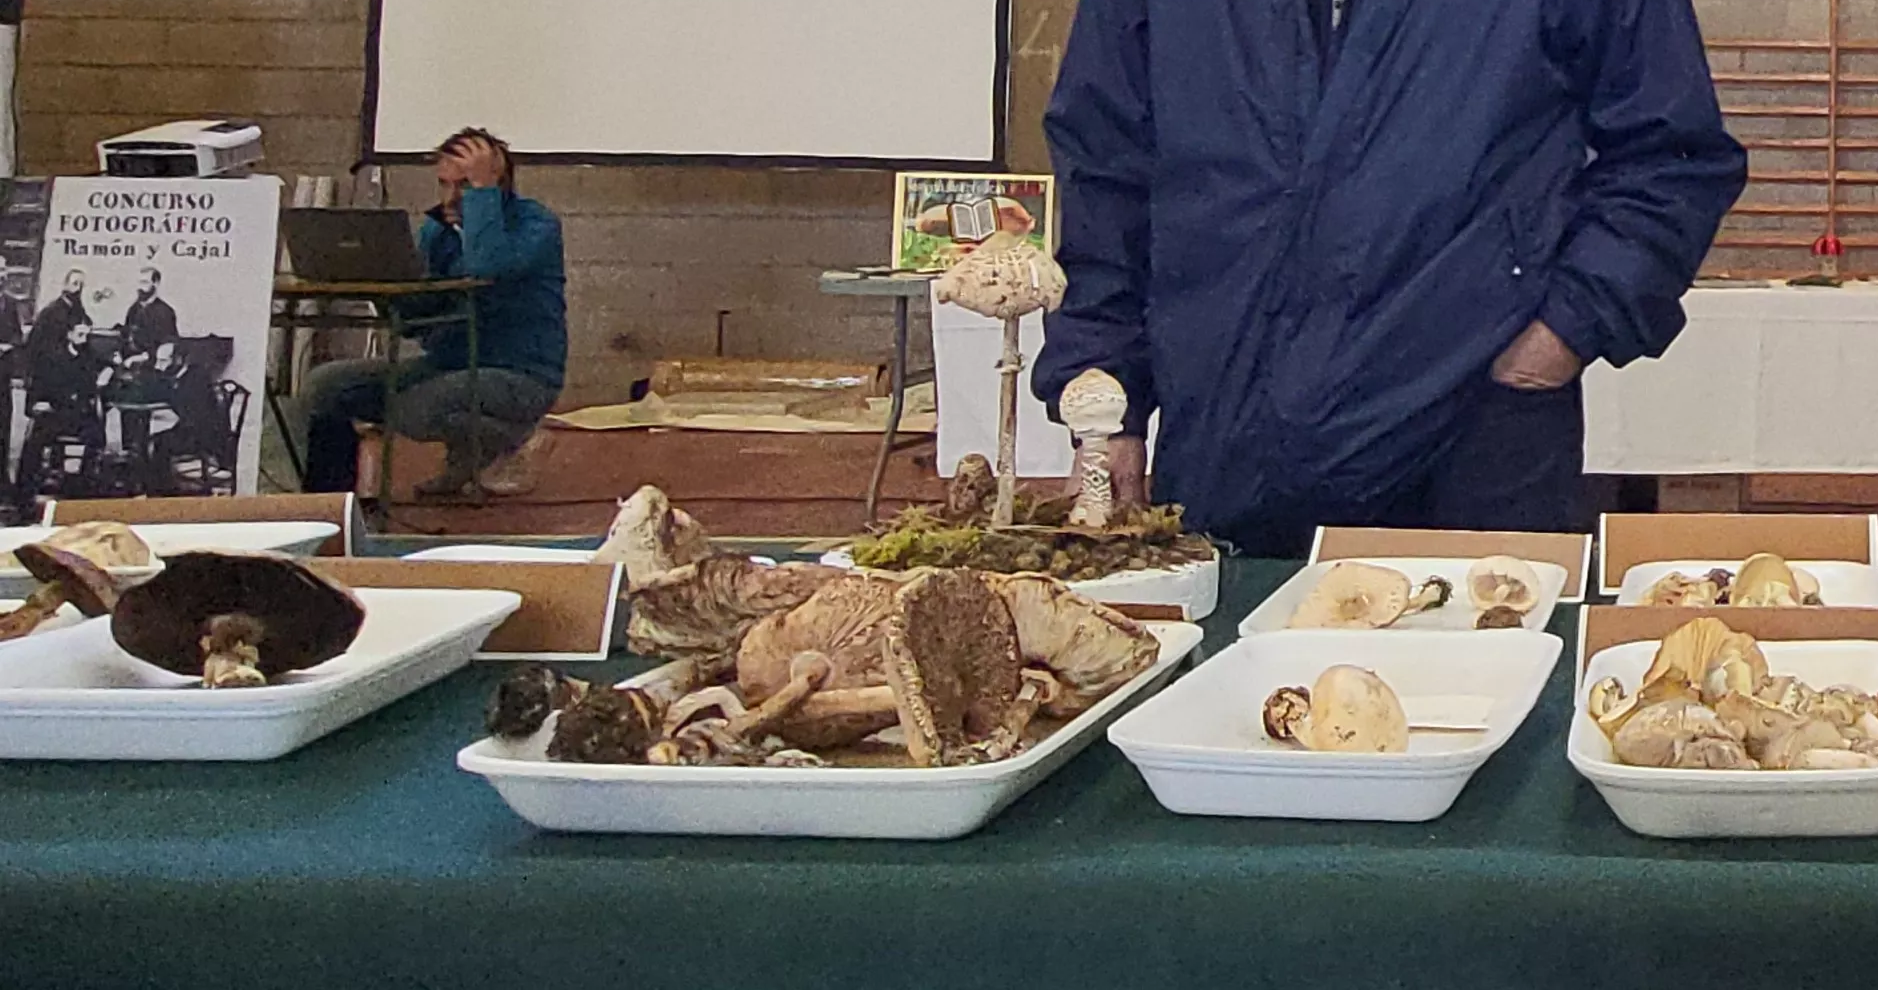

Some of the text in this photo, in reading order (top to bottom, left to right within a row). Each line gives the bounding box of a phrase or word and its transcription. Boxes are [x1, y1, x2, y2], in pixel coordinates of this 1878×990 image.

[88, 191, 214, 210] CONCURSO
[59, 212, 232, 234] FOTOGRÁFICO
[147, 244, 160, 259] y
[171, 239, 231, 260] Cajal
